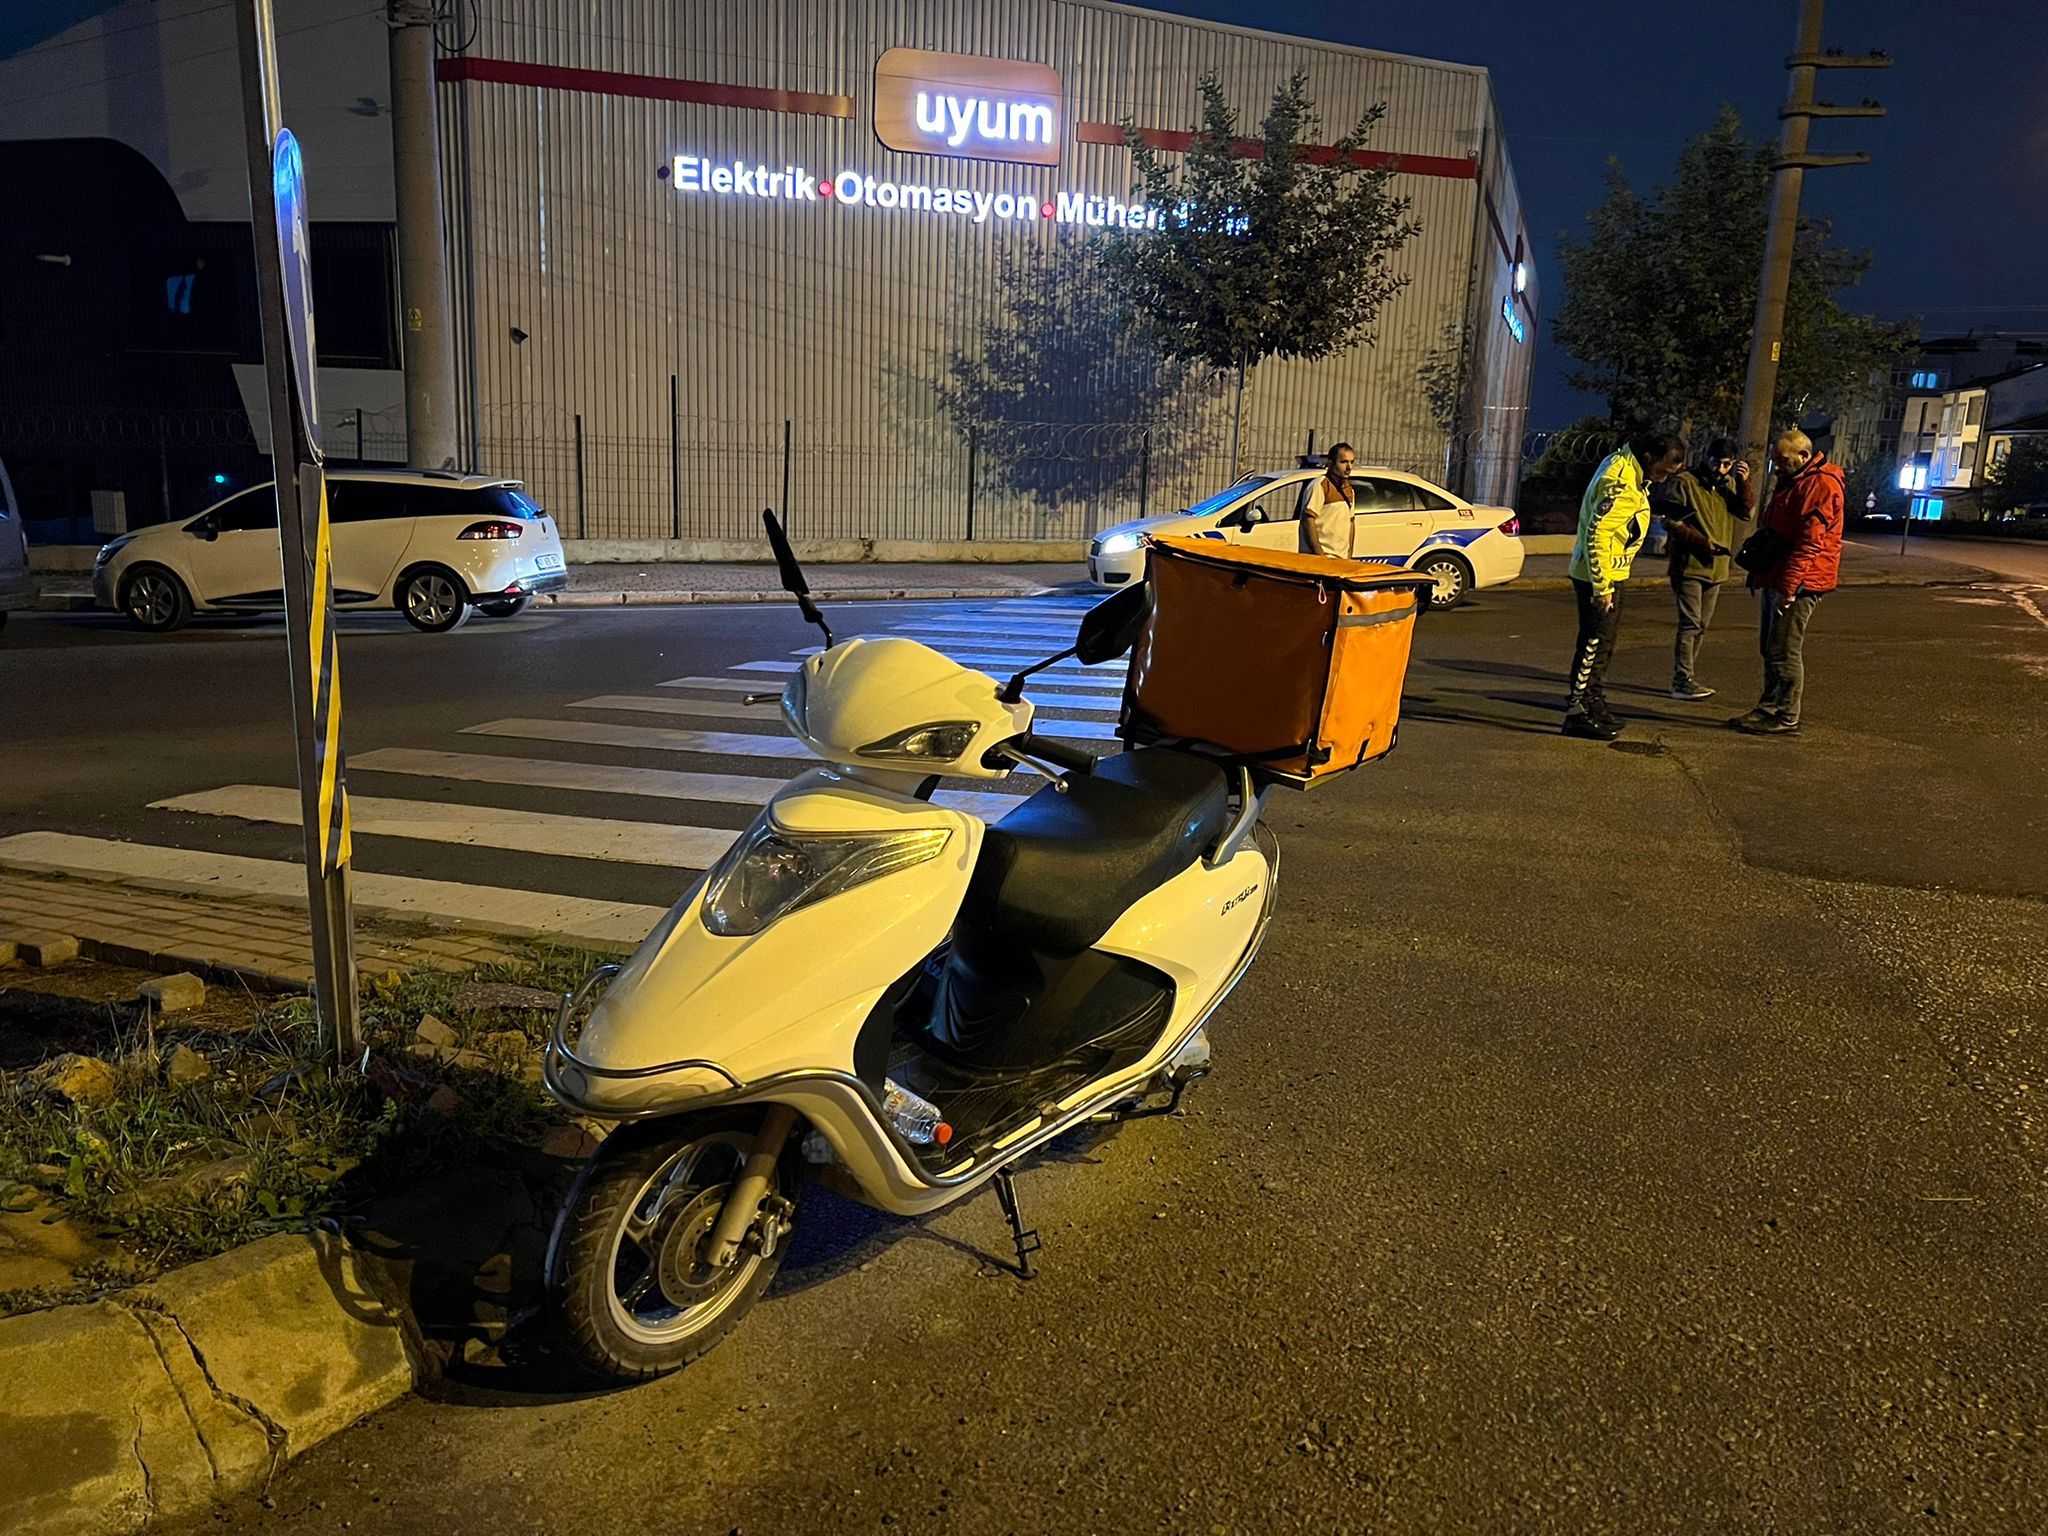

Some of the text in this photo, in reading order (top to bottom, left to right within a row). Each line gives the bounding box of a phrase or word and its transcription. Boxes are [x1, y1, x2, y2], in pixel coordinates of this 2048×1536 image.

[915, 92, 1052, 146] uyum
[673, 156, 816, 200] Elektrik
[834, 171, 1037, 223] Otomasyon
